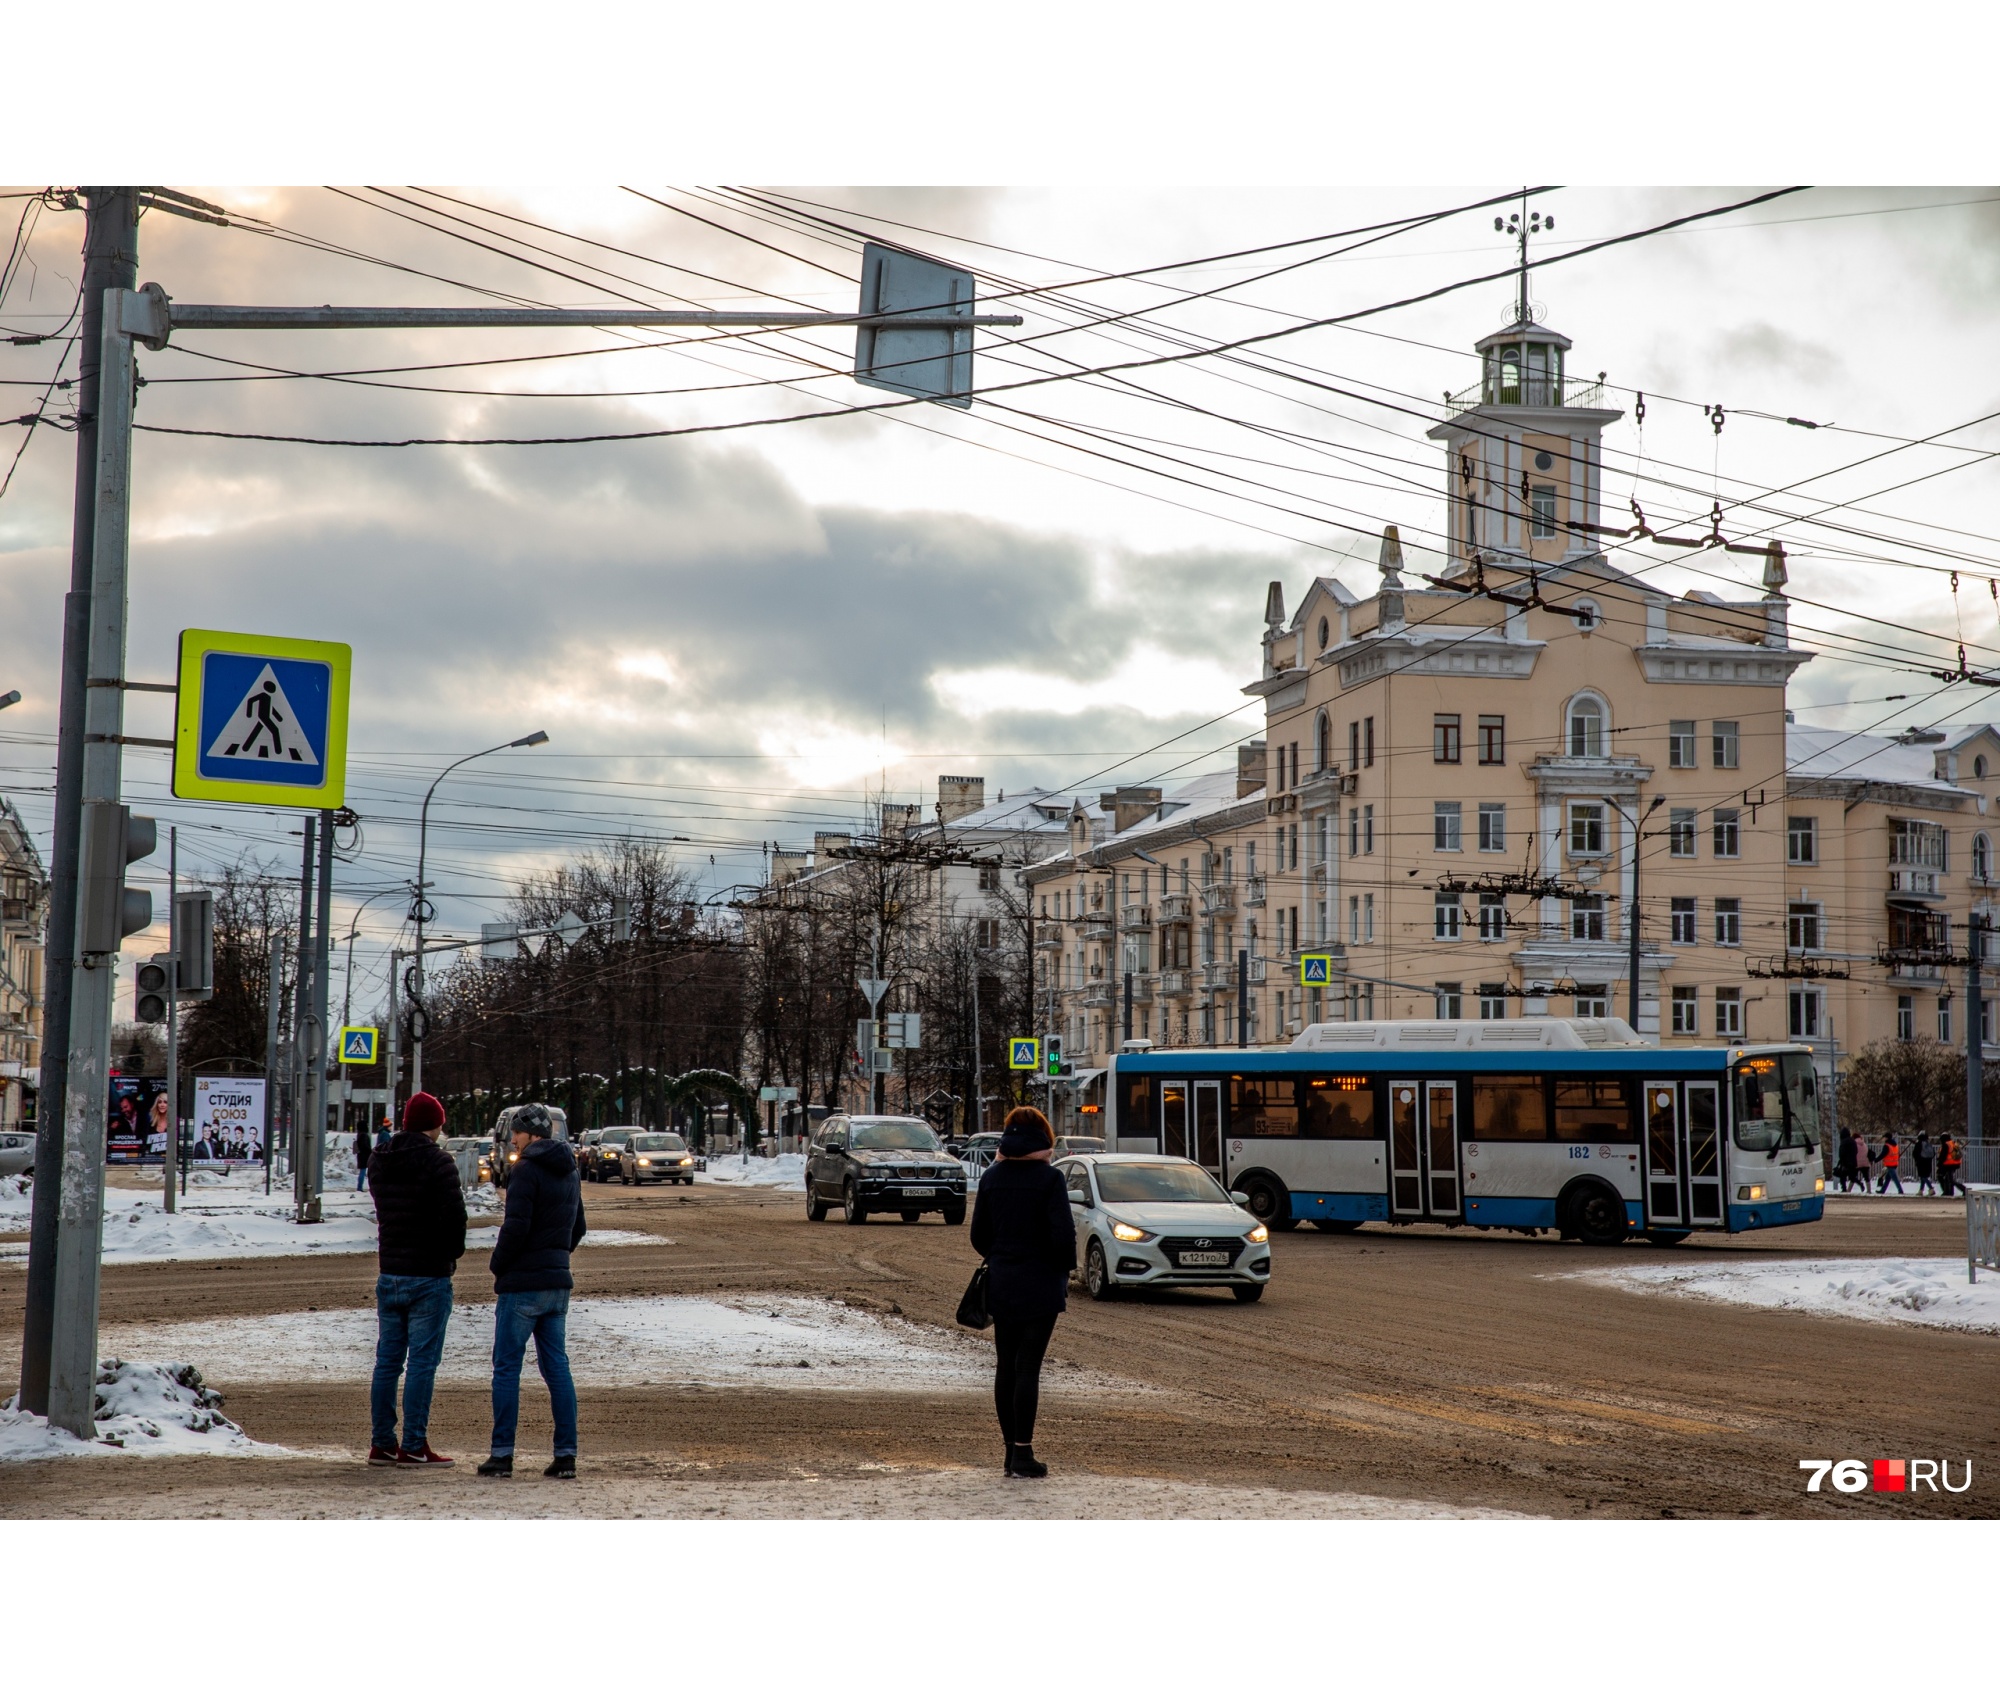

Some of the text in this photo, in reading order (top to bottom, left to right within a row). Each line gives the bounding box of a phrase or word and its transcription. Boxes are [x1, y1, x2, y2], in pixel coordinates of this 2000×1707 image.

[198, 1081, 209, 1091] 28
[208, 1094, 252, 1107] СТУДИЯ
[212, 1108, 248, 1120] СОЮЗ
[1568, 1146, 1590, 1159] 182
[1781, 1167, 1803, 1176] ЛИАЗ
